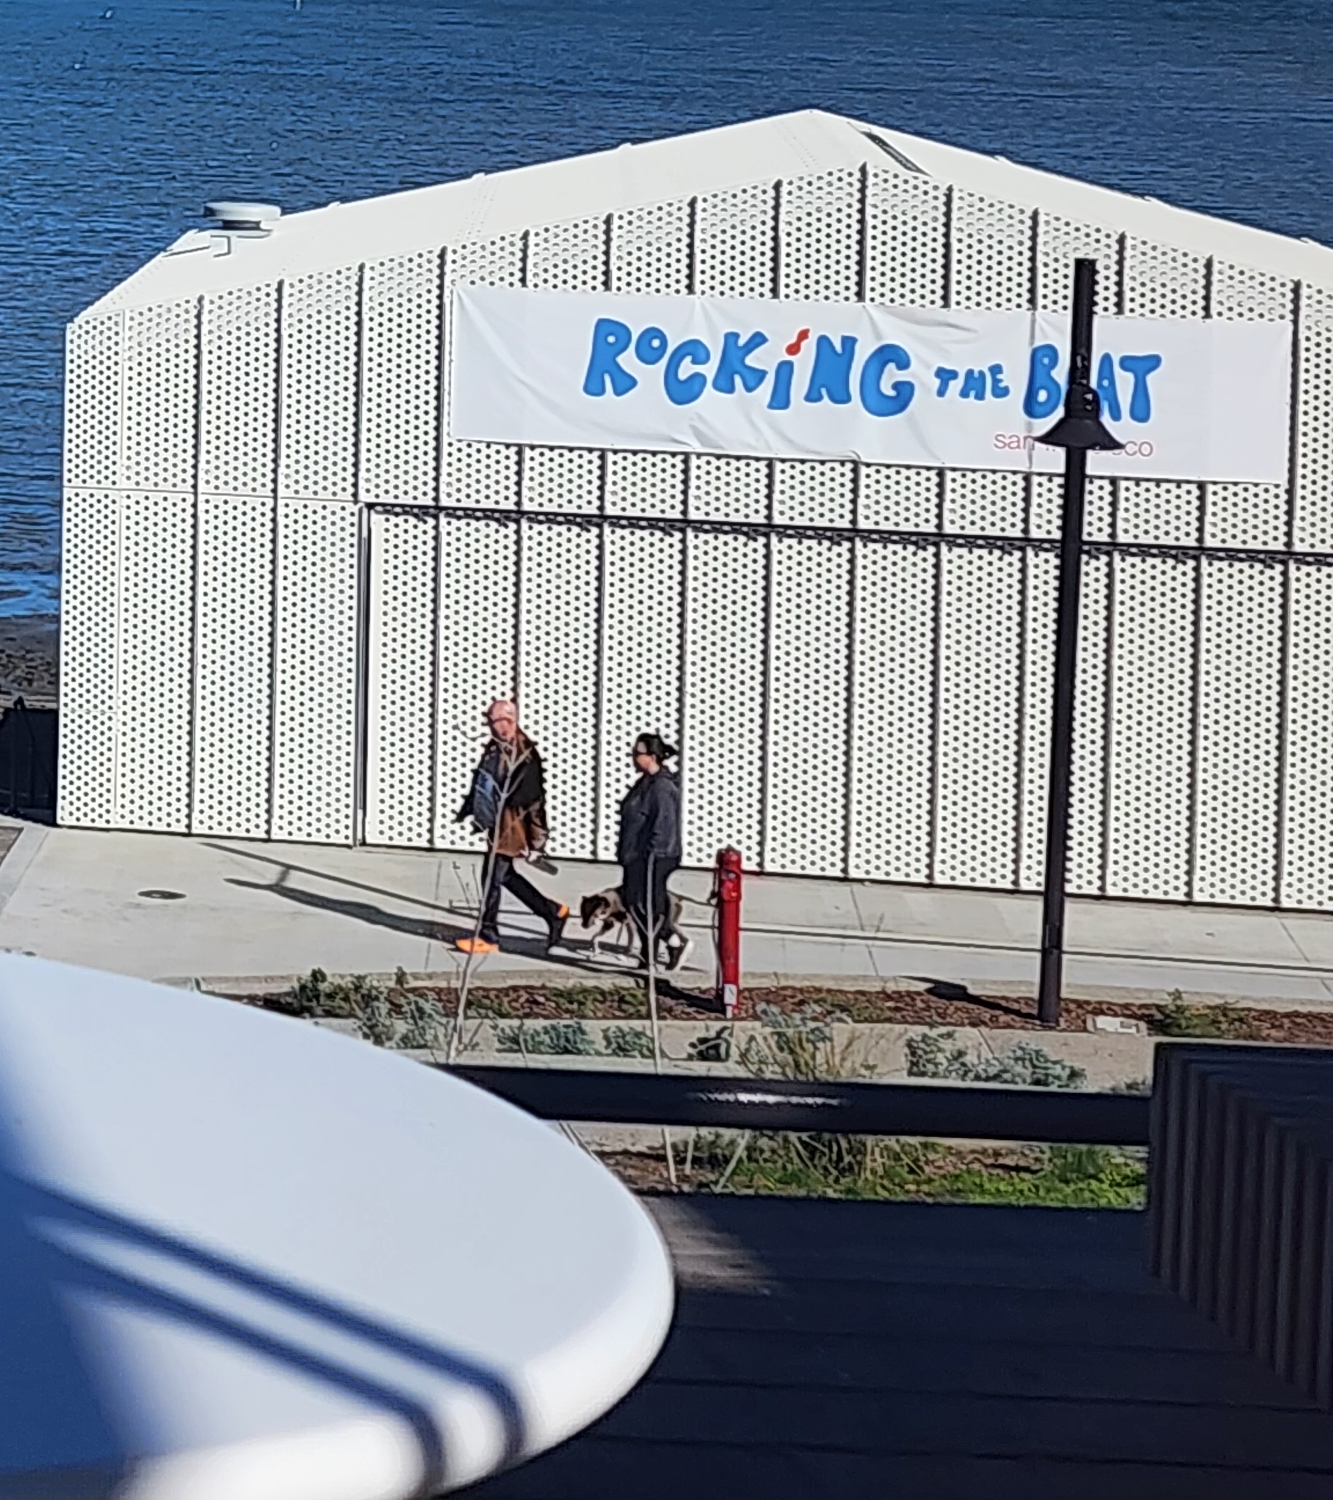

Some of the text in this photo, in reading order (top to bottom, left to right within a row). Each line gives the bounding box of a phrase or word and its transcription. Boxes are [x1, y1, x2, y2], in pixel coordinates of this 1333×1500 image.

[935, 363, 1010, 401] THE
[1023, 343, 1162, 423] BAT
[994, 433, 1035, 450] san
